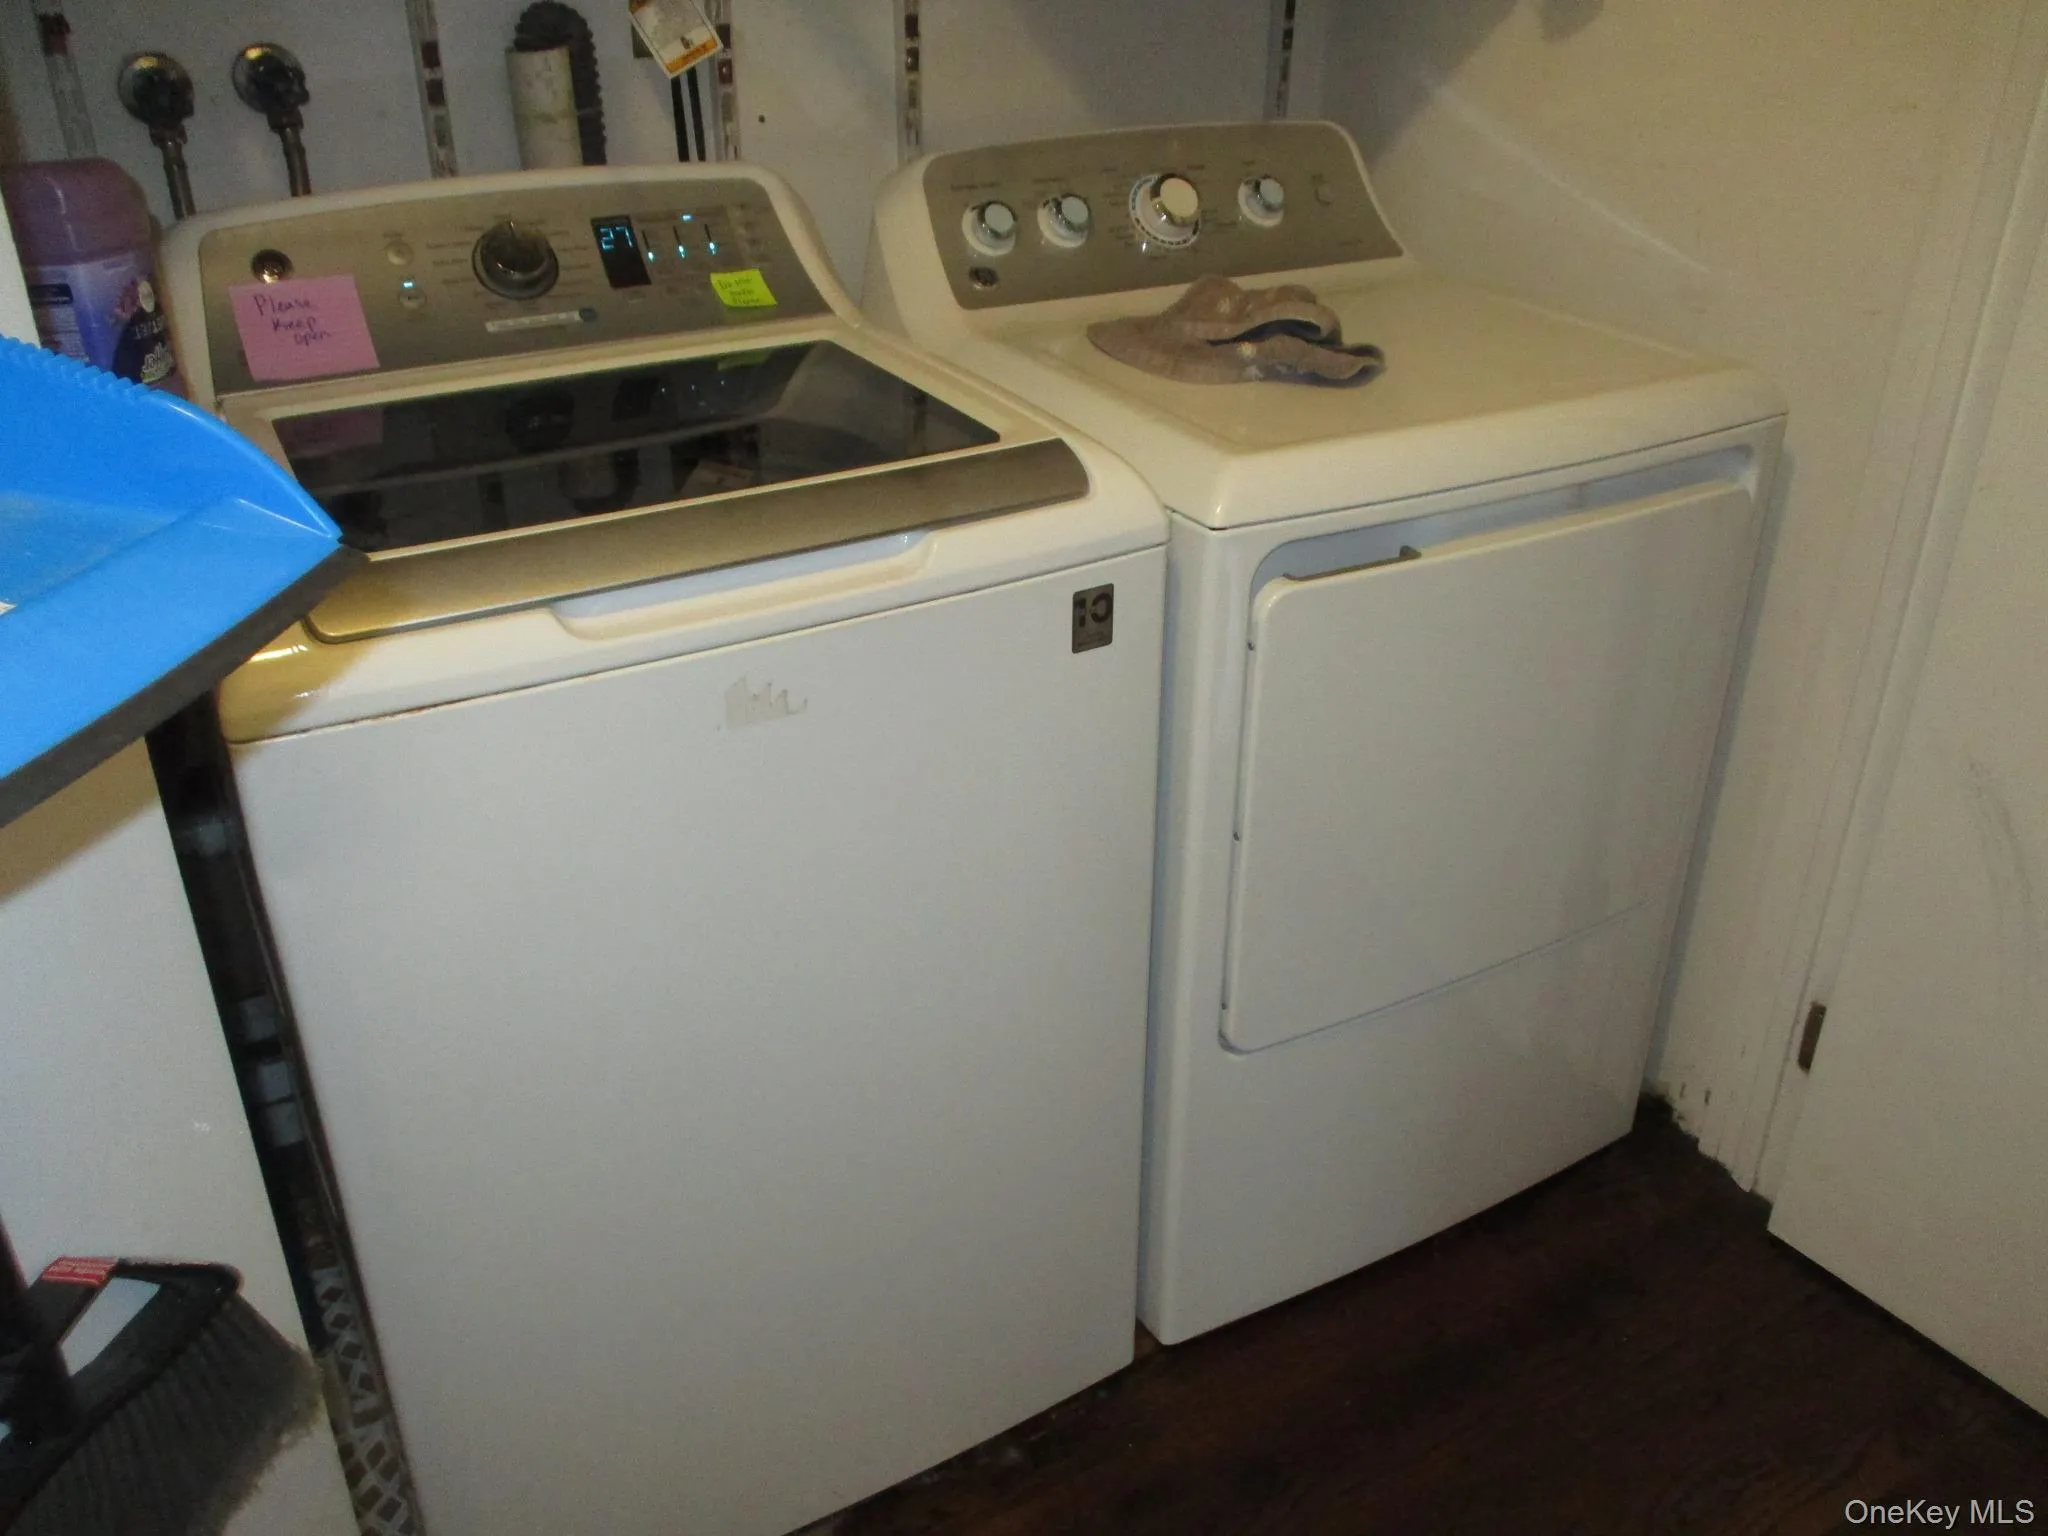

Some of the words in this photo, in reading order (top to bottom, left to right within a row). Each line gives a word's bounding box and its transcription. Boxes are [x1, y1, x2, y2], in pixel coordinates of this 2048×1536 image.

[600, 226, 633, 250] 27
[252, 294, 315, 316] Please
[294, 330, 331, 346] open
